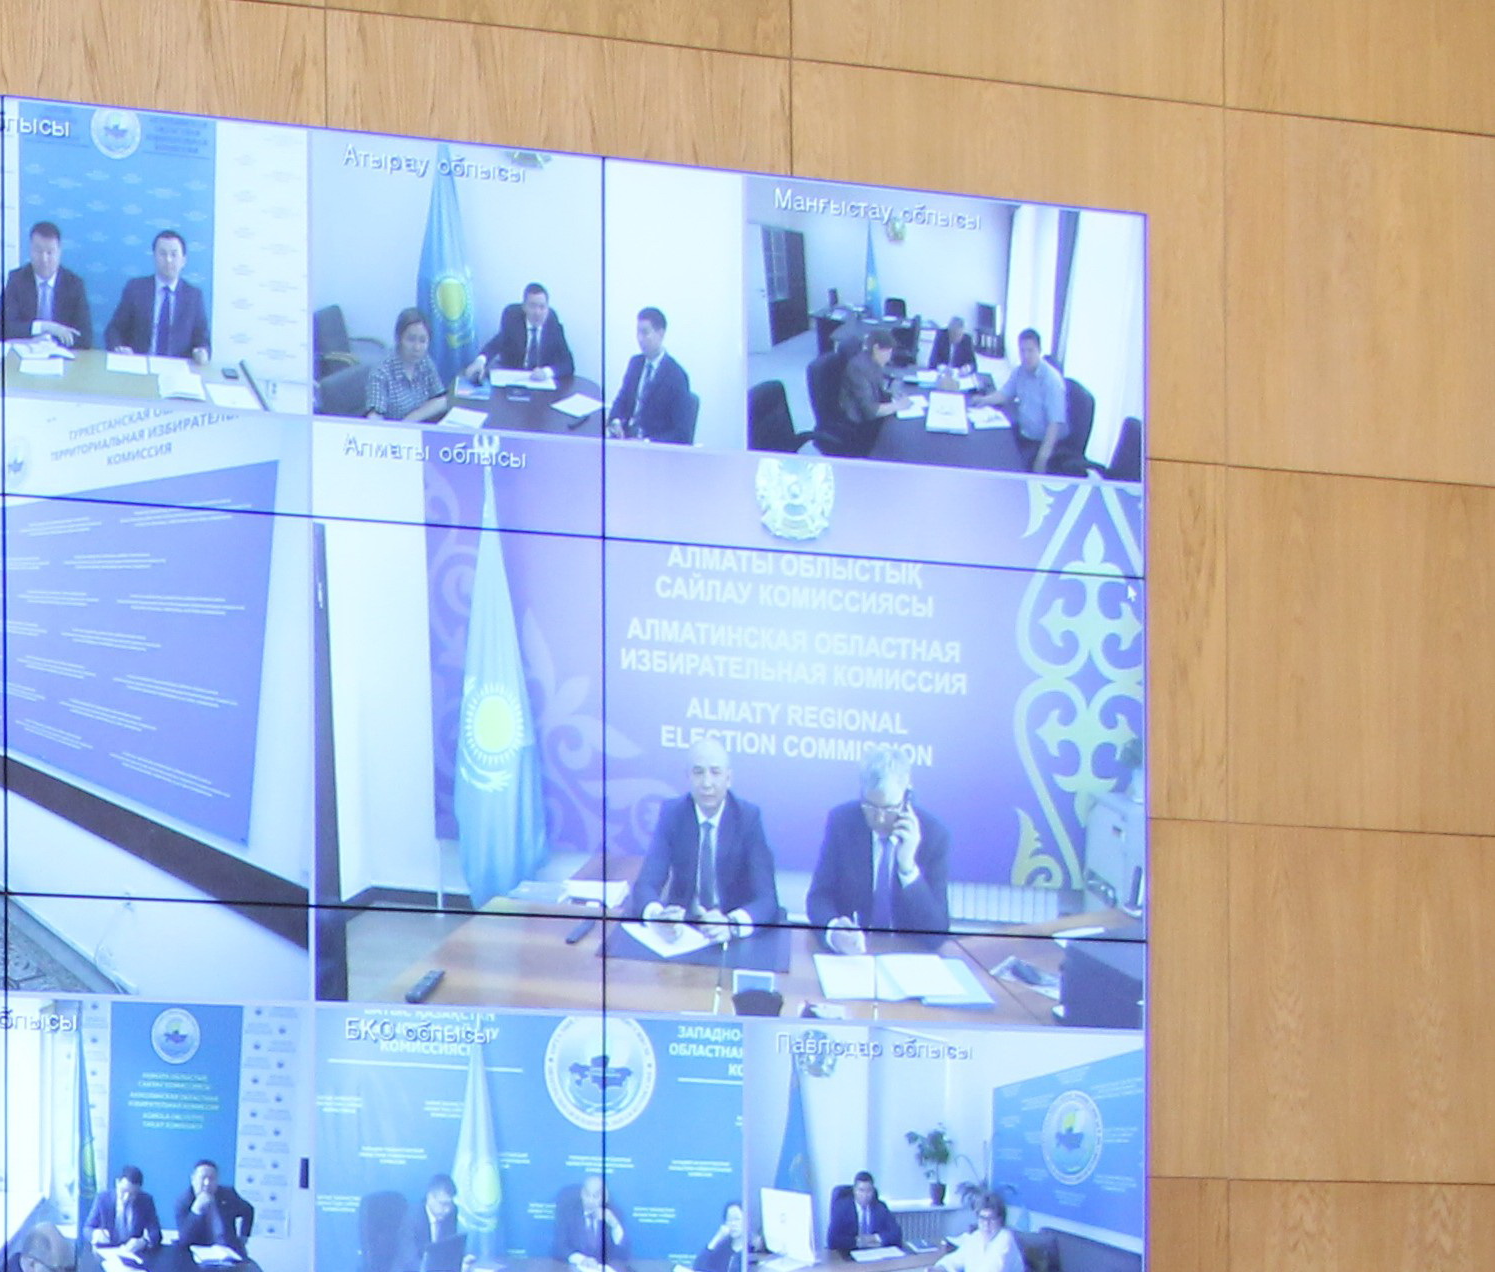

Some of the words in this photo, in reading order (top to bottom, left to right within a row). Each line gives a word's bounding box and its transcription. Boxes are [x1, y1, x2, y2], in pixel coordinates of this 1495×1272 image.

[342, 144, 429, 177] Атырау
[439, 156, 527, 183] облысы
[901, 206, 982, 230] облысы
[106, 442, 172, 465] КОМИССИЯ
[343, 432, 429, 462] Алматы
[439, 441, 527, 469] облысы
[667, 544, 773, 577] АЛМАТЫ
[780, 552, 923, 589] ОБЛЫСТЫҚ
[655, 572, 752, 601] САЙЛАУ
[759, 584, 934, 618] КОМИССИЯСЫ
[626, 616, 809, 653] АЛМАТИНСКАЯ
[815, 631, 961, 663] ОБЛАСТНАЯ
[620, 648, 826, 684] ИЗБИРАТЕЛЬНАЯ
[833, 663, 968, 695] КОМИССИЯ
[686, 697, 782, 726] ALMATY
[787, 705, 908, 735] REGIONAL
[405, 1019, 494, 1044] облысы
[775, 1032, 883, 1058] Павлодар
[892, 1038, 973, 1060] облысы
